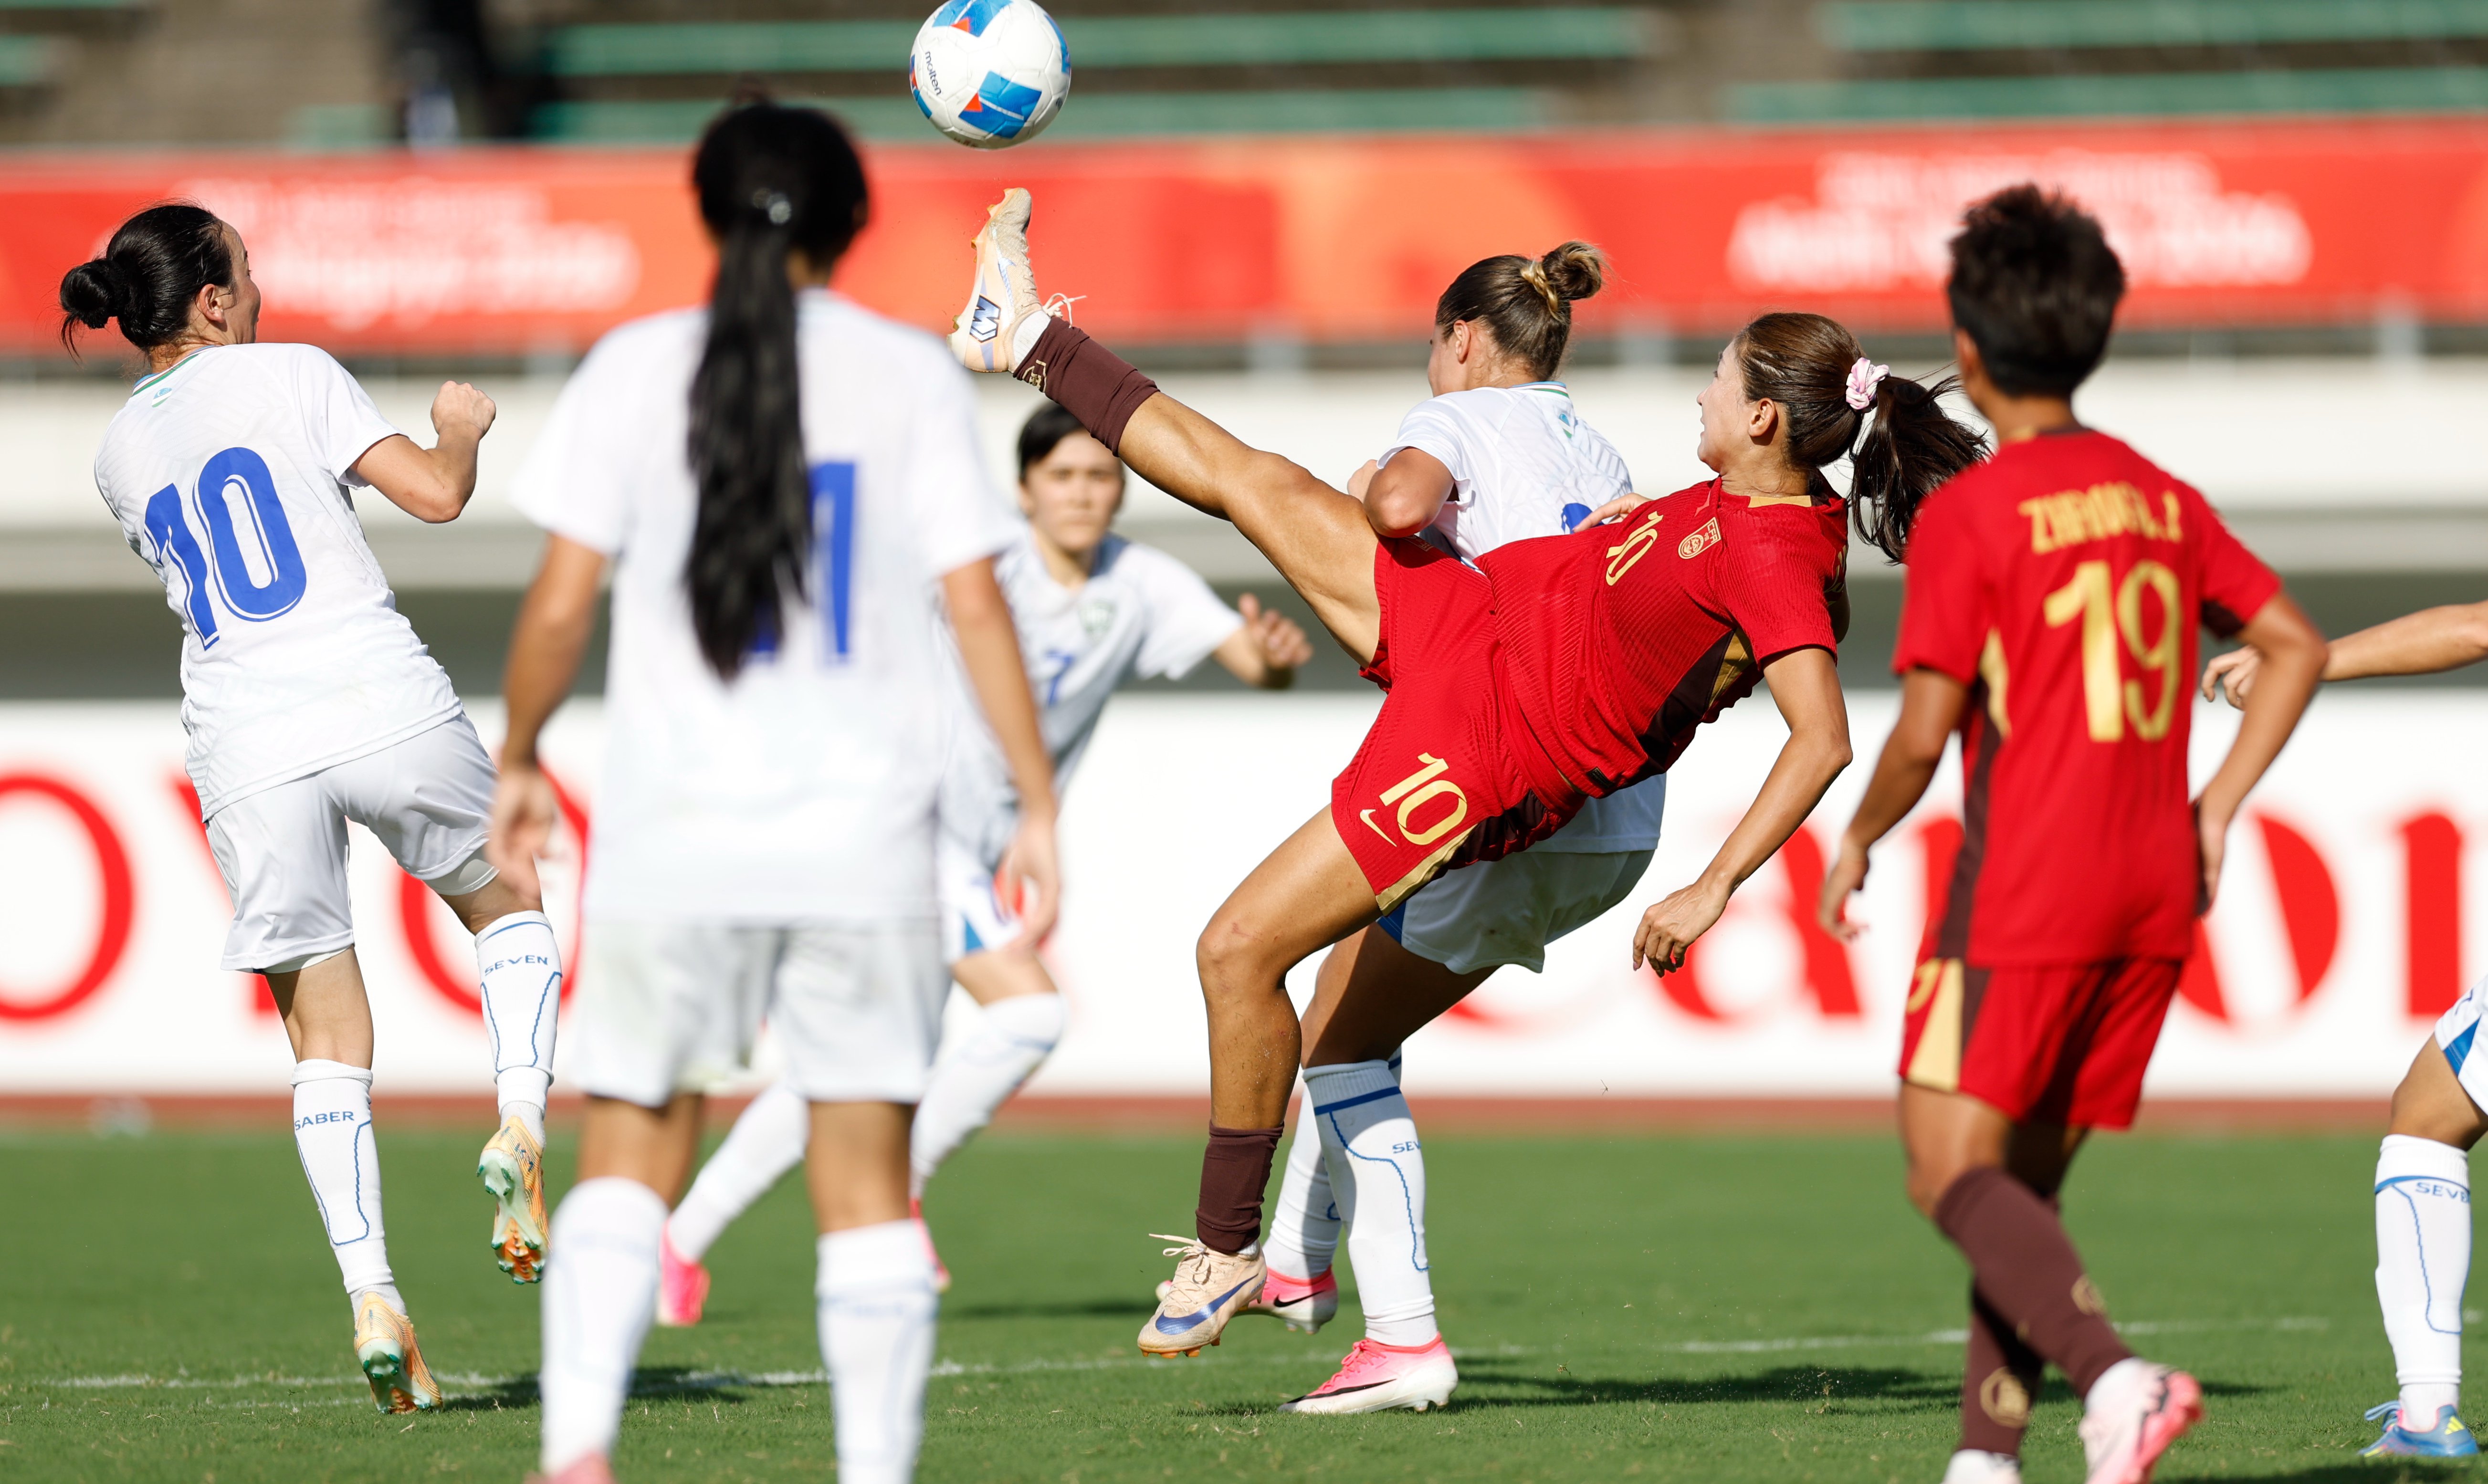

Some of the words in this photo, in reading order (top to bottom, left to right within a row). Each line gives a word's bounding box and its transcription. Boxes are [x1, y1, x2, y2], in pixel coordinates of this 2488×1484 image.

[925, 51, 941, 96] molten
[144, 447, 307, 651] 10
[1606, 511, 1664, 586] 10
[1707, 521, 1718, 543] CFA
[1045, 648, 1075, 712] 7
[2043, 559, 2182, 742] 19
[1379, 752, 1467, 845] 10
[484, 955, 548, 976] SEVEN
[294, 1111, 355, 1130] SABER
